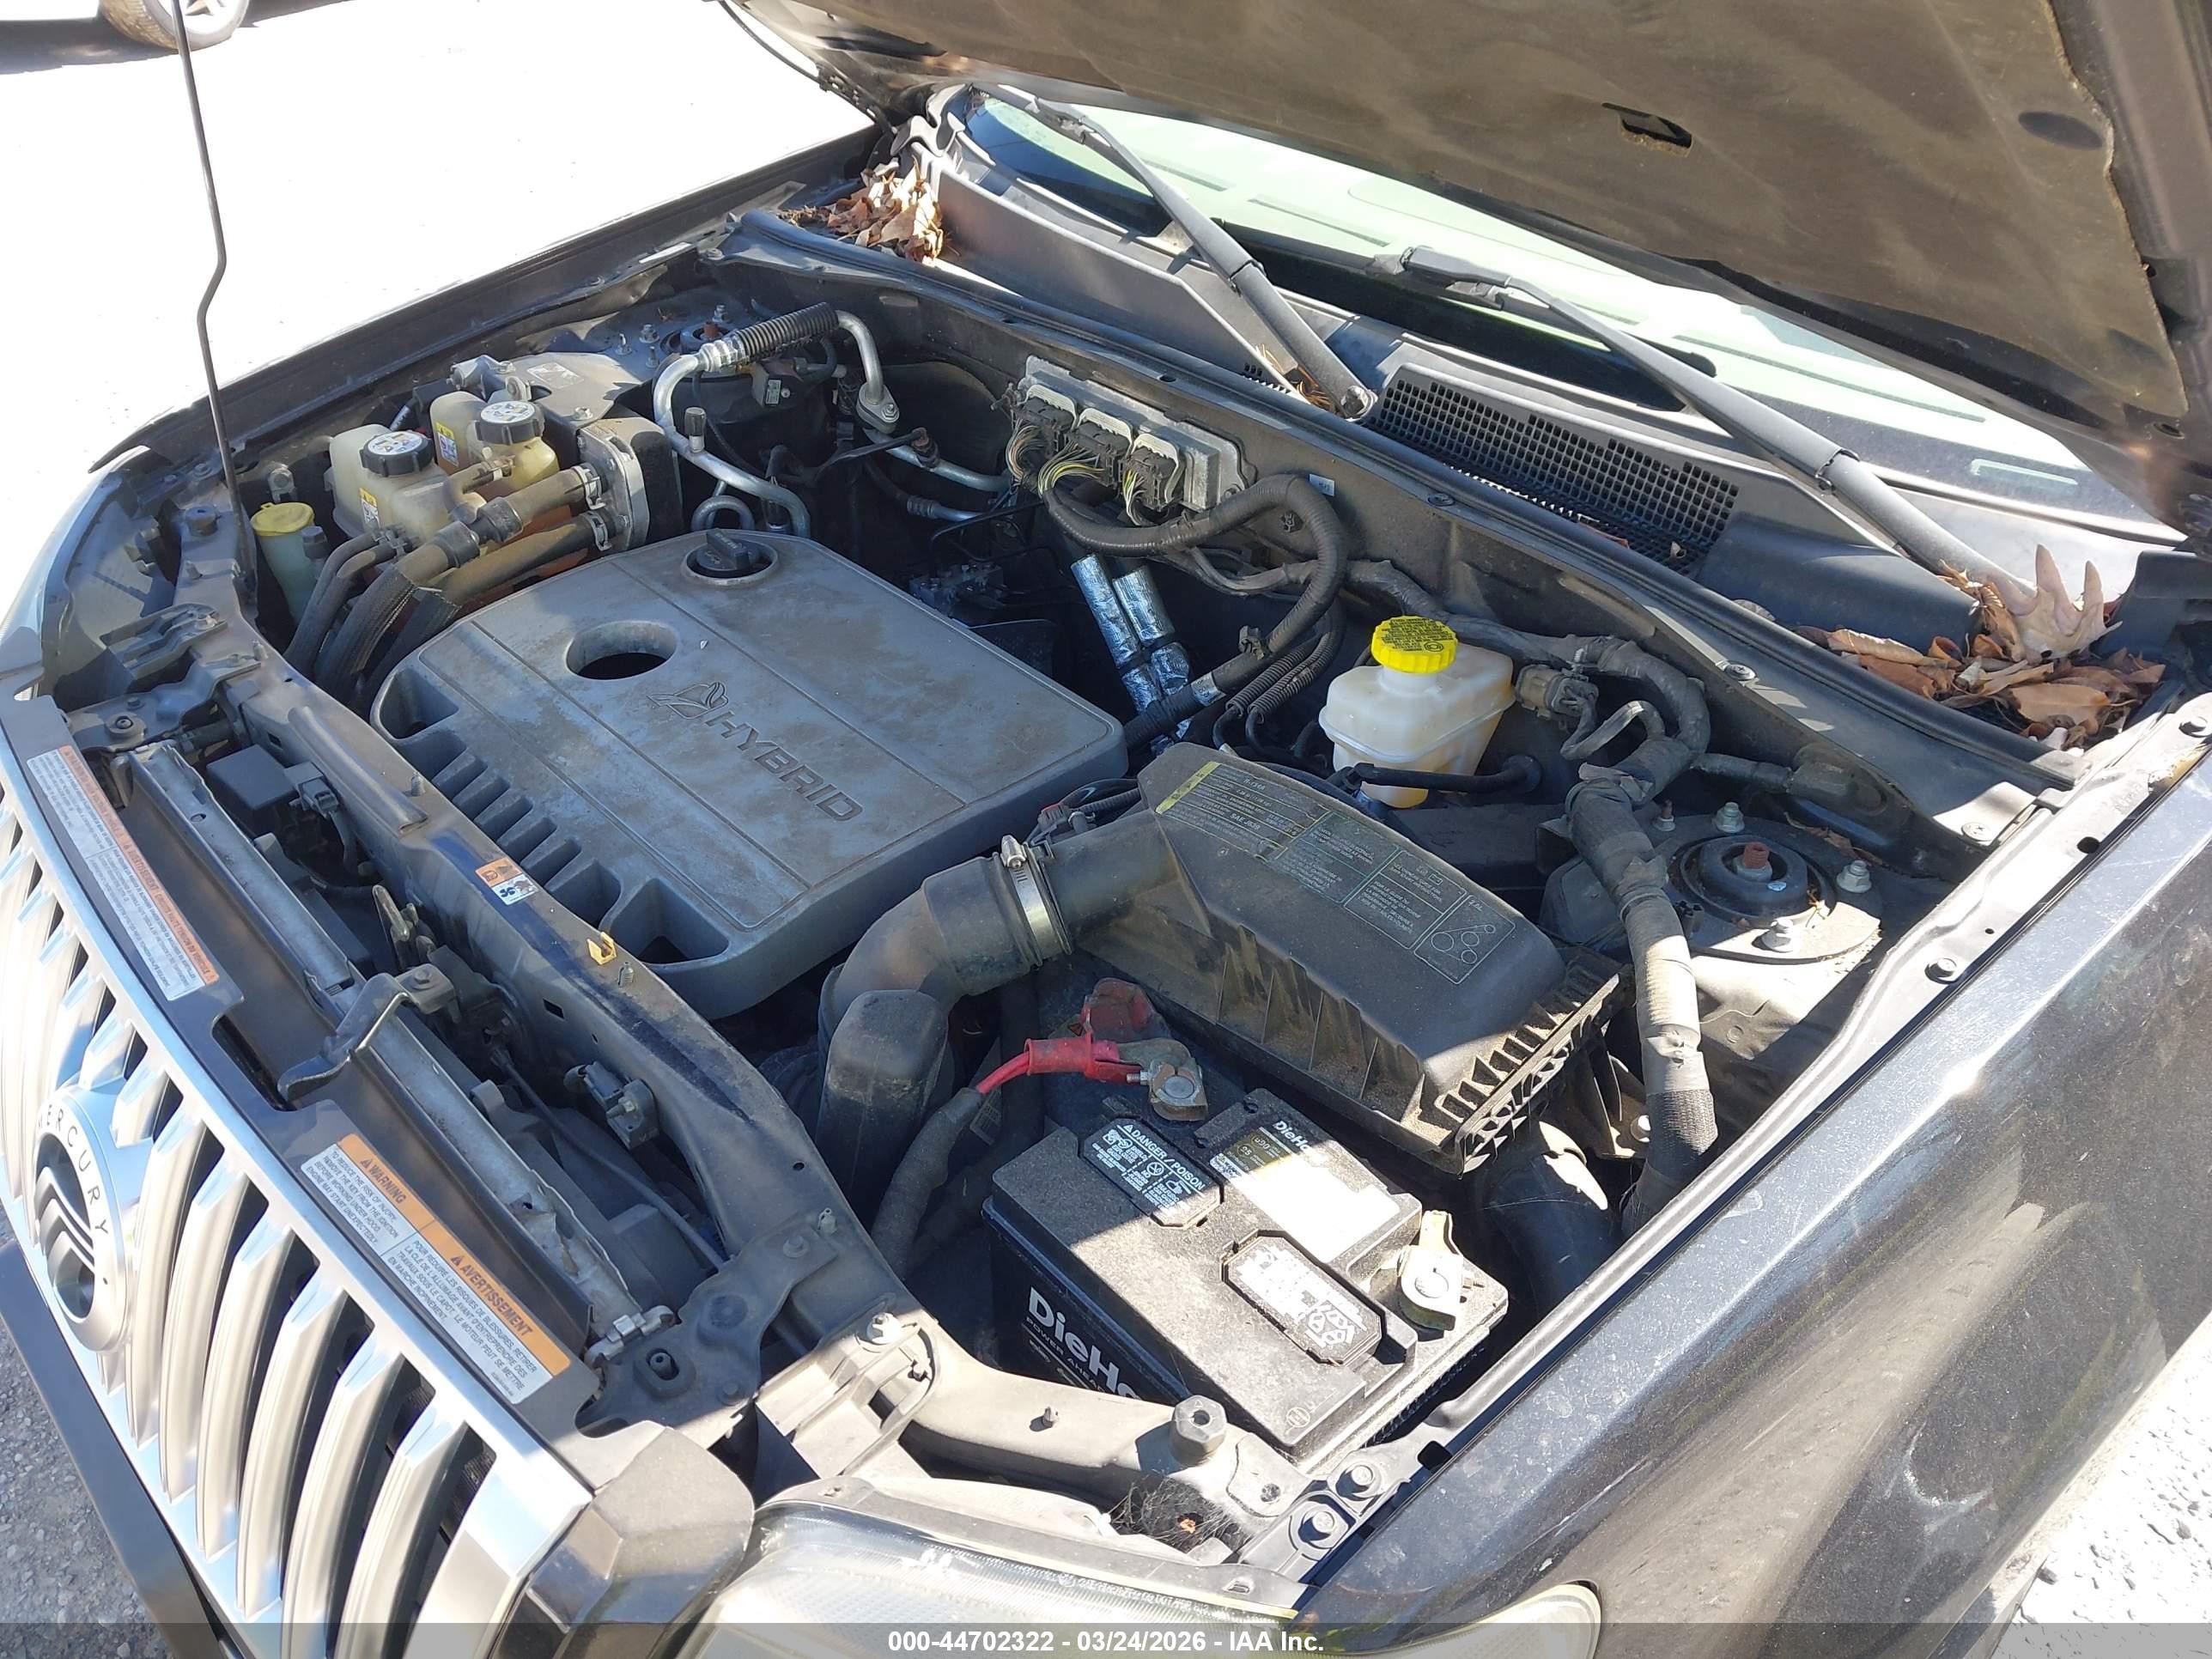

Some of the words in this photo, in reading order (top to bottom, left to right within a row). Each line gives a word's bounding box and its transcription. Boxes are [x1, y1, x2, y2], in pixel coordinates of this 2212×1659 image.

[704, 709, 863, 822] HYBRID
[1230, 812, 1245, 823] SAE
[306, 1166, 324, 1185] ENGINE
[320, 1182, 332, 1194] MAY
[329, 1191, 346, 1209] START
[330, 1150, 338, 1159] TO
[336, 1157, 356, 1177] REDUCE
[353, 1175, 364, 1187] THE
[362, 1184, 374, 1197] RISK
[371, 1194, 381, 1205] OF
[368, 1164, 407, 1204] WARNING
[1130, 1129, 1167, 1159] DANGER
[1170, 1161, 1205, 1190] POISON
[1139, 1169, 1152, 1178] NO
[313, 1160, 332, 1181] BEFORE
[330, 1178, 352, 1202] WORKING
[349, 1200, 367, 1218] UNDER
[321, 1155, 341, 1176] REMOVE
[338, 1174, 349, 1186] THE
[347, 1182, 358, 1195] KEY
[356, 1192, 371, 1209] FROM
[368, 1206, 380, 1218] THE
[377, 1215, 398, 1238] IGNITION
[386, 1255, 397, 1267] EN
[393, 1263, 416, 1287] MARCHE
[411, 1239, 428, 1256] POUR
[444, 1274, 458, 1288] LES
[453, 1285, 478, 1310] RISQUES
[474, 1307, 485, 1318] DE
[459, 1261, 532, 1338] AVERTISSEMENT
[395, 1250, 419, 1275] TRAVAUX
[415, 1272, 432, 1290] SOUS
[428, 1286, 438, 1297] LE
[453, 1313, 463, 1324] LE
[459, 1321, 483, 1346] MOTEUR
[480, 1343, 496, 1360] PEUT
[493, 1357, 504, 1369] SE
[501, 1365, 525, 1391] METTRE
[404, 1244, 414, 1255] LA
[419, 1261, 430, 1273] DE
[454, 1300, 474, 1320] AVANT
[513, 1364, 527, 1378] DES
[1026, 1316, 1064, 1356] POWER
